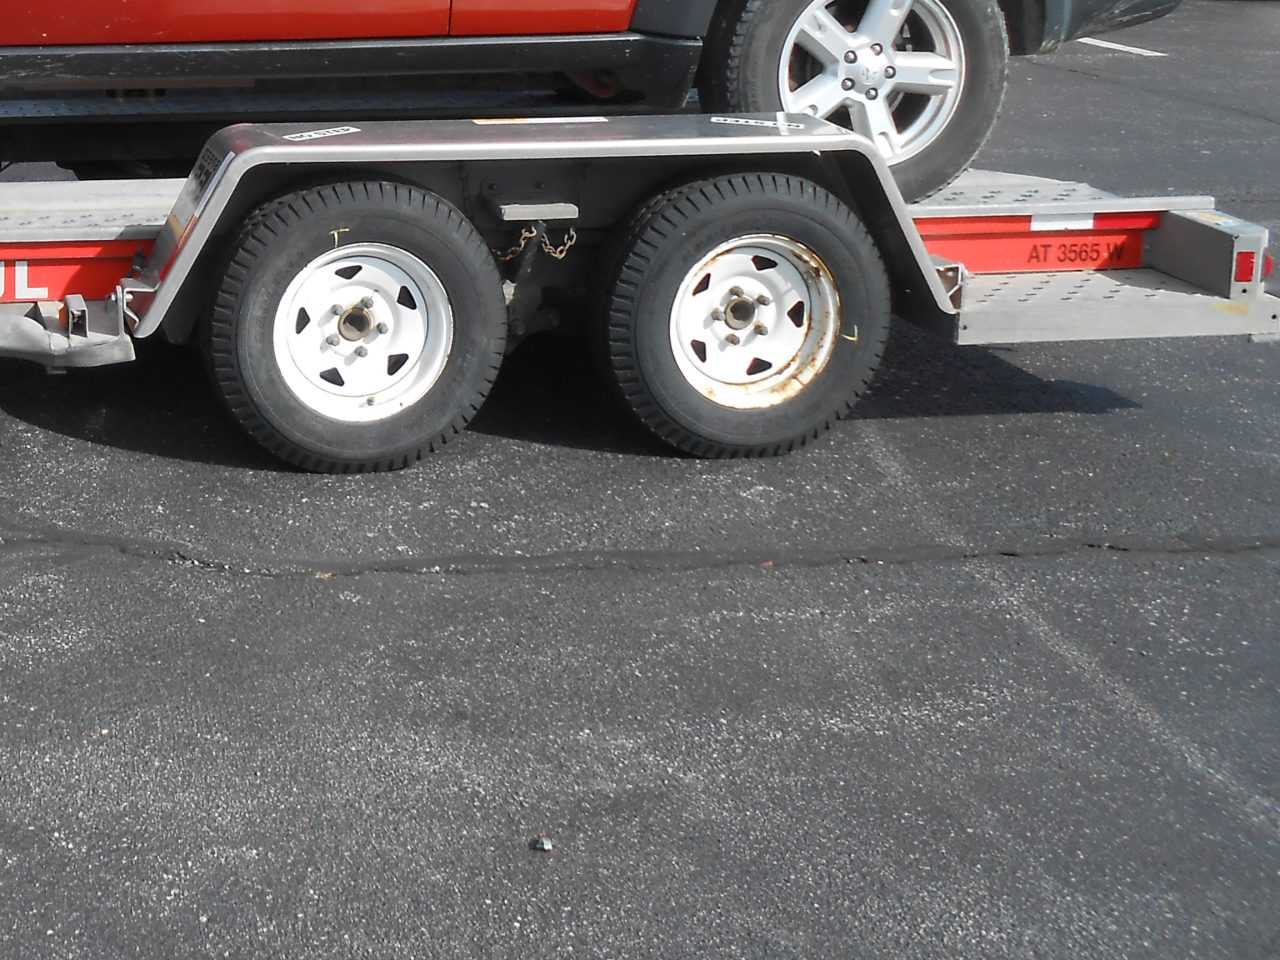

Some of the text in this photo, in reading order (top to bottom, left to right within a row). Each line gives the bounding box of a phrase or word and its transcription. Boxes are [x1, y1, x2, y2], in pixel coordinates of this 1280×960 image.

[1027, 242, 1125, 263] AT 3565 W
